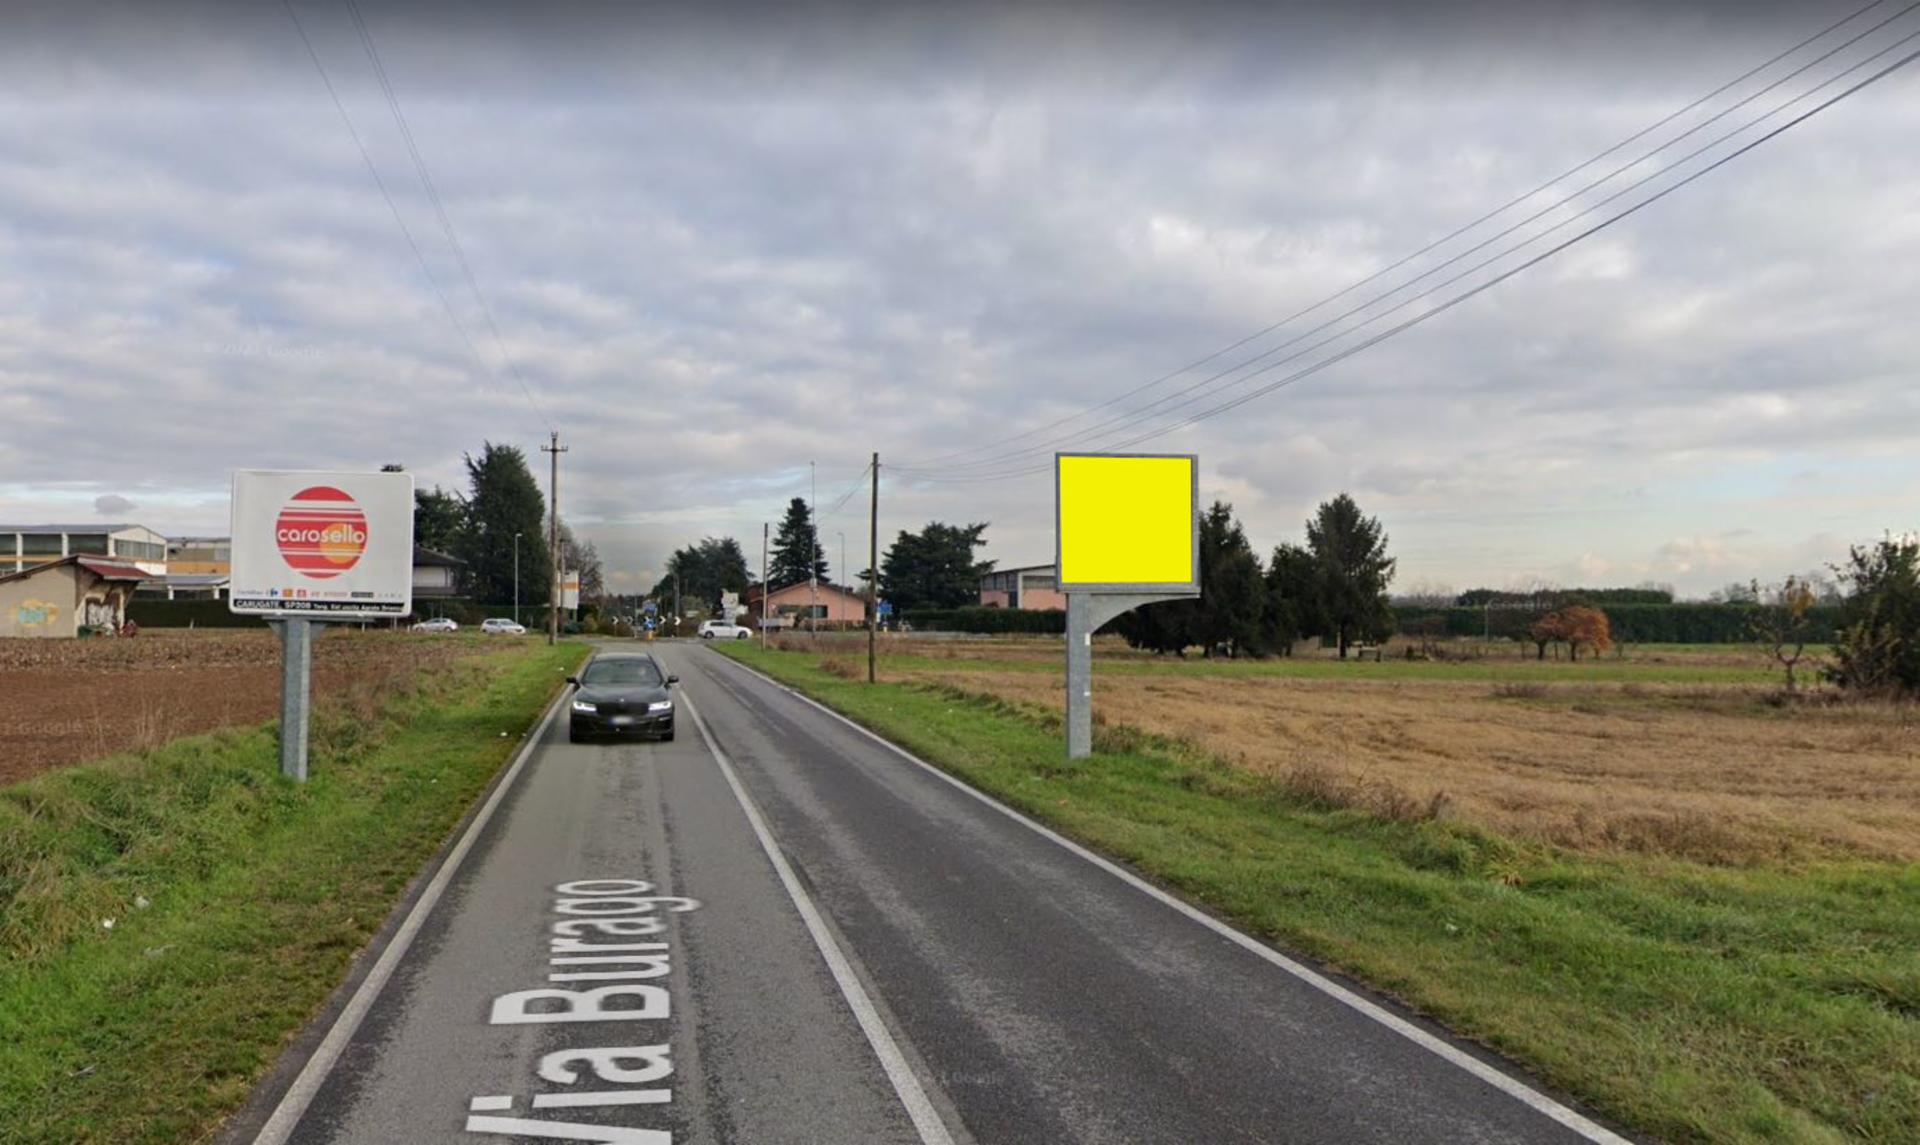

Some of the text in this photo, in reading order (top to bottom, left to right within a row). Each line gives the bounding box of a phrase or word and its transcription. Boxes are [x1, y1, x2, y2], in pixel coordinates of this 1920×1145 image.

[277, 524, 366, 544] carosello
[465, 879, 701, 1145] Via Burago
